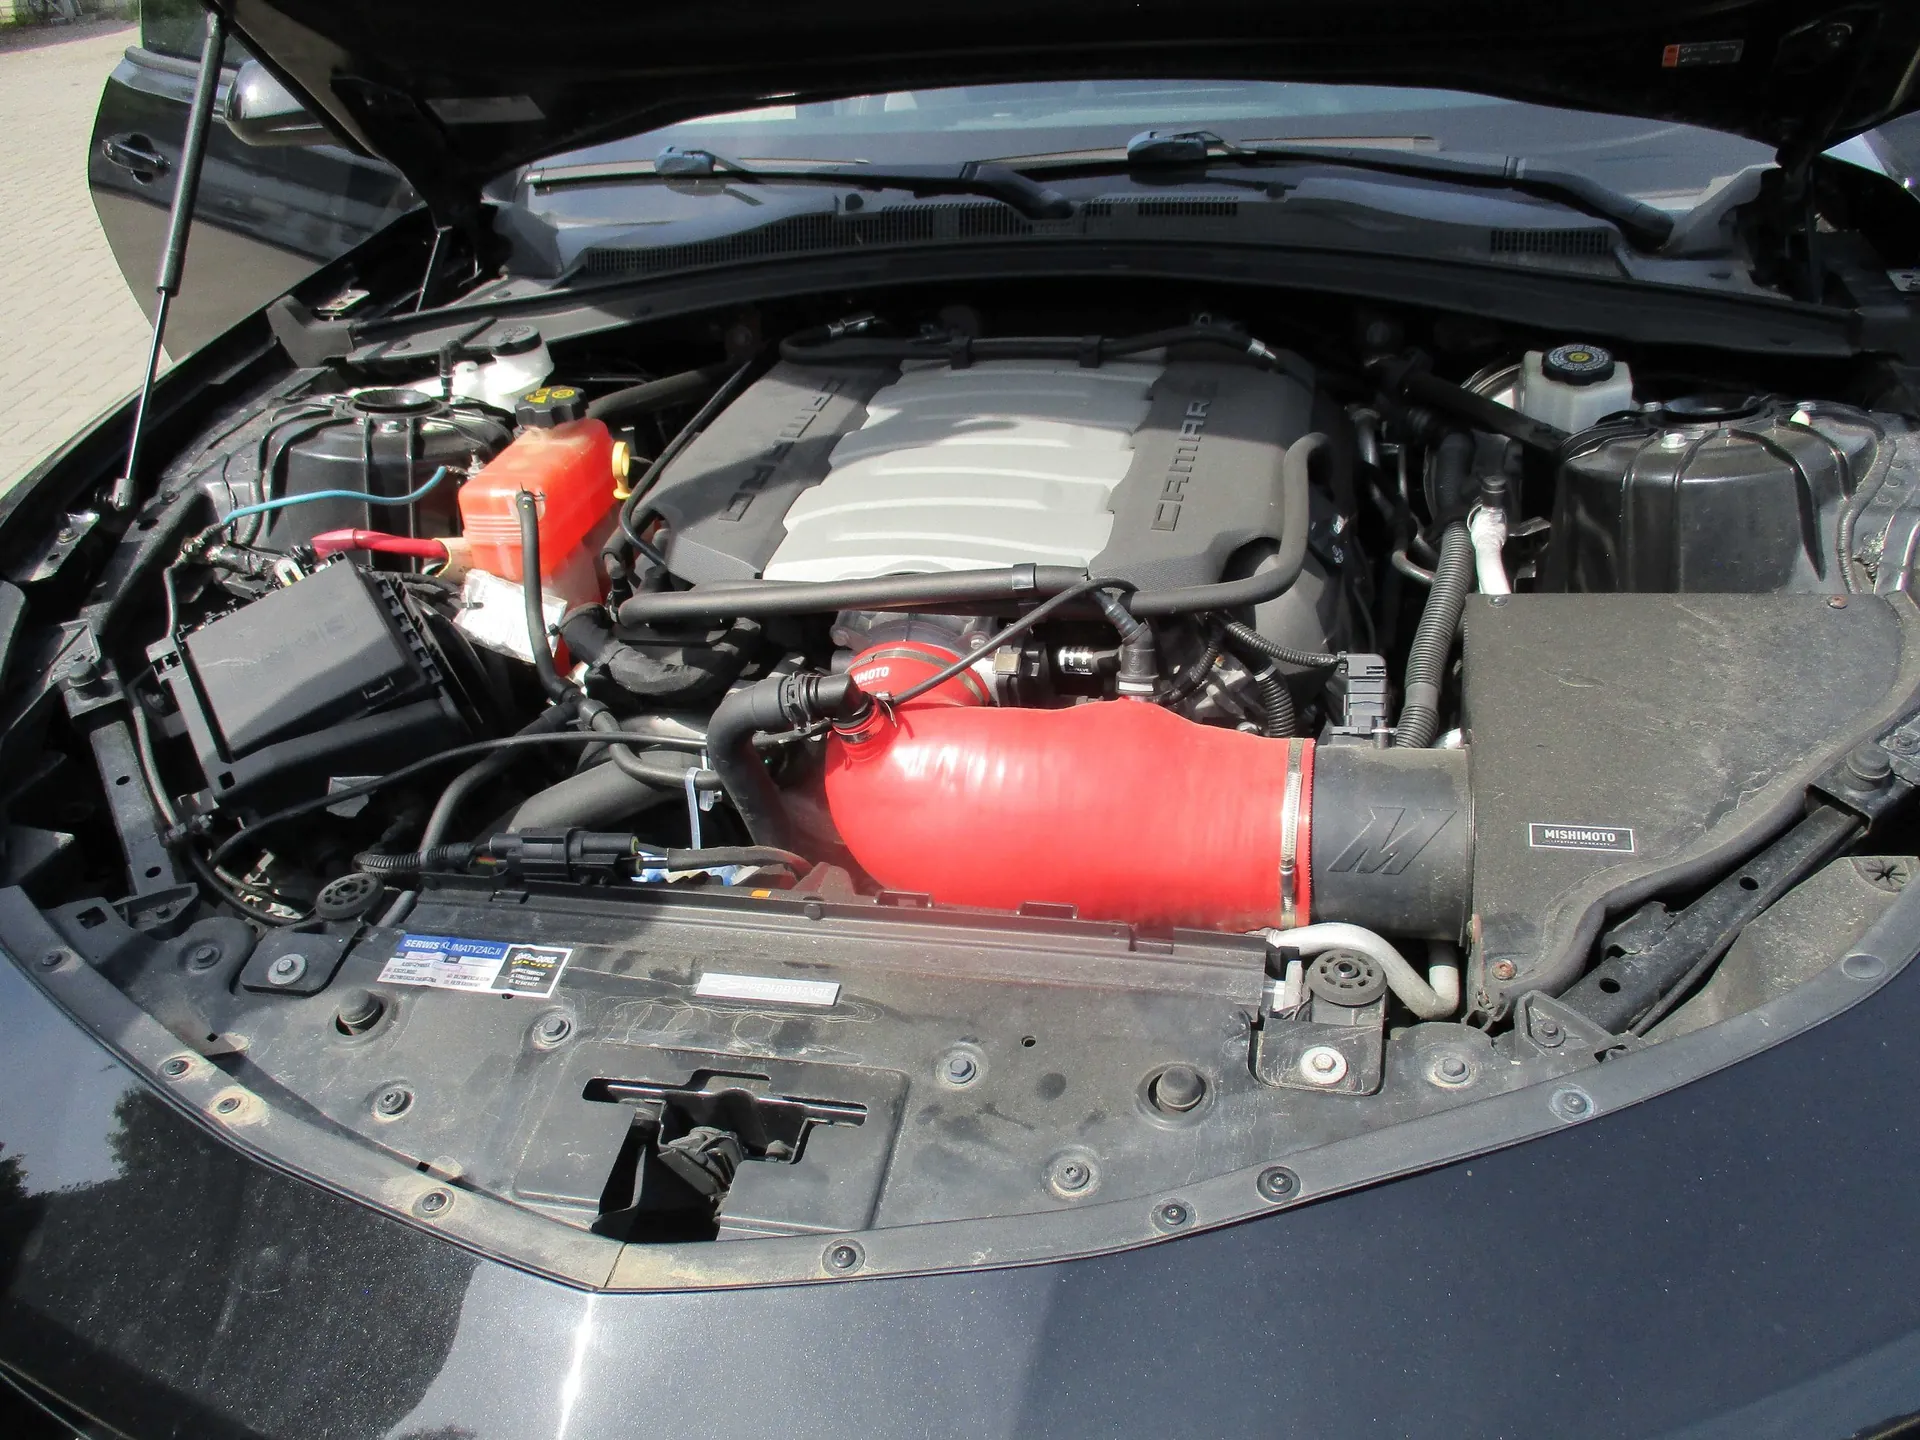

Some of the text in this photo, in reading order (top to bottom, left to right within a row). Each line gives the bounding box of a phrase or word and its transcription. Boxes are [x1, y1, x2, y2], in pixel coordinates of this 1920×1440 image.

[1544, 829, 1616, 843] MISHIMOTO
[404, 939, 502, 955] SERWIS KLIMATYZACJI
